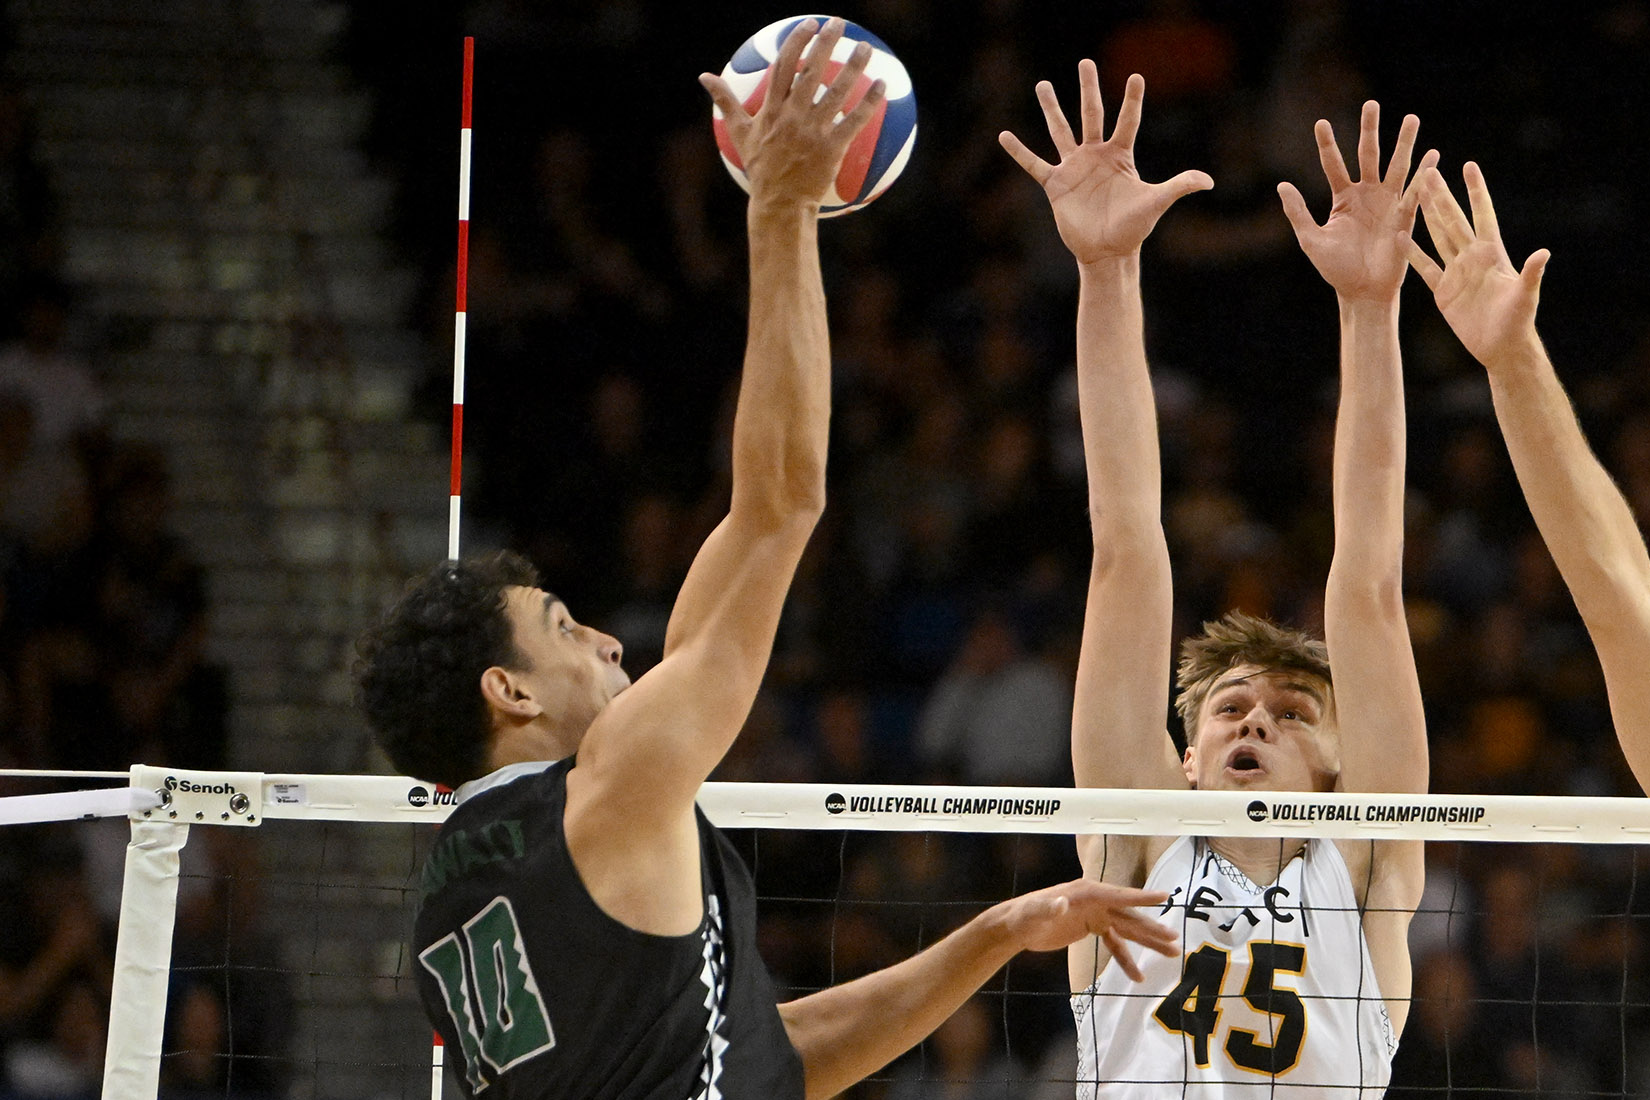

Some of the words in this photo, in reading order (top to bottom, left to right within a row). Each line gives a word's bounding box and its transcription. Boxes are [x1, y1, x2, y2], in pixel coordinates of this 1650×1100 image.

[180, 780, 236, 795] Senoh
[850, 796, 938, 814] VOLLEYBALL
[942, 798, 1061, 816] CHAMPIONSHIP
[1272, 803, 1361, 822] VOLLEYBALL
[1365, 805, 1485, 823] CHAMPIONSHIP
[418, 896, 556, 1095] 10
[1152, 941, 1308, 1079] 45
